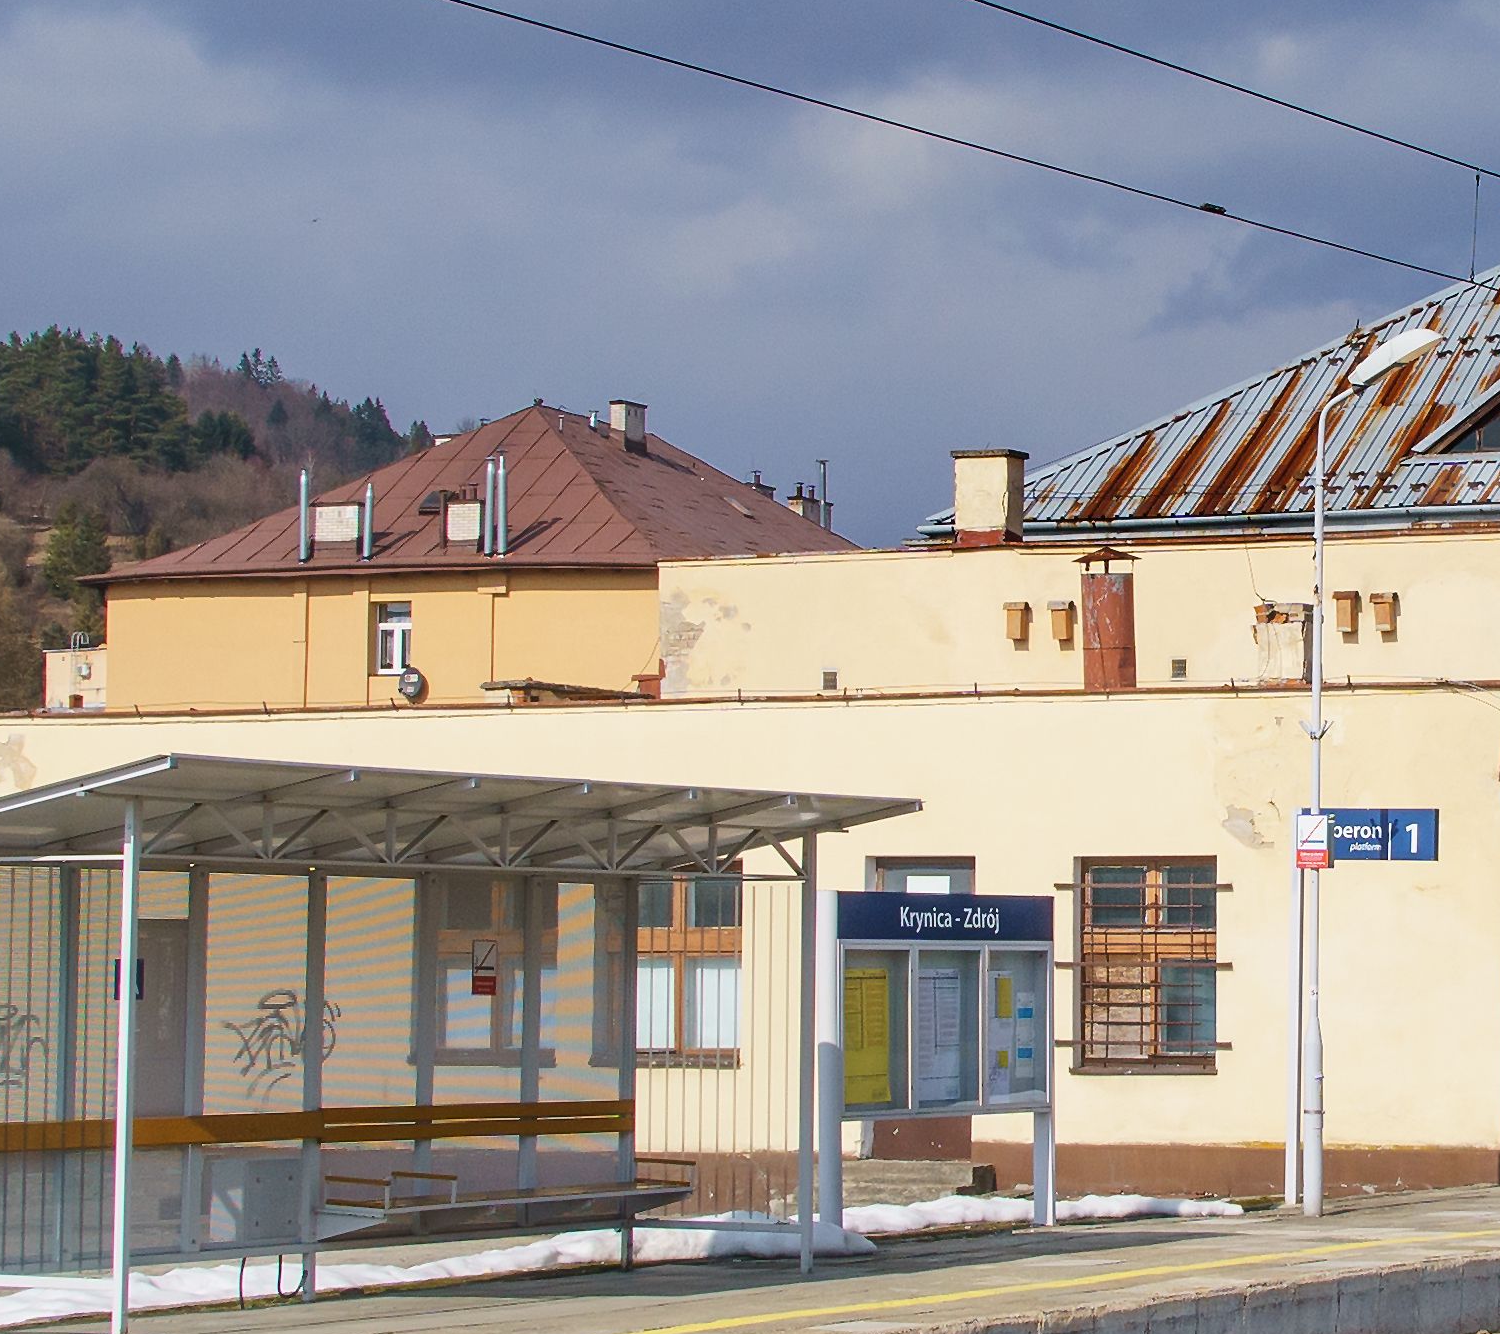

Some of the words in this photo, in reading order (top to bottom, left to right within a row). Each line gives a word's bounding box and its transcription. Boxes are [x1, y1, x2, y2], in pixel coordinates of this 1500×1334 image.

[1349, 841, 1382, 853] platform
[1405, 823, 1418, 854] 1
[900, 907, 953, 933] Krynica
[963, 907, 1000, 934] Zdrój
